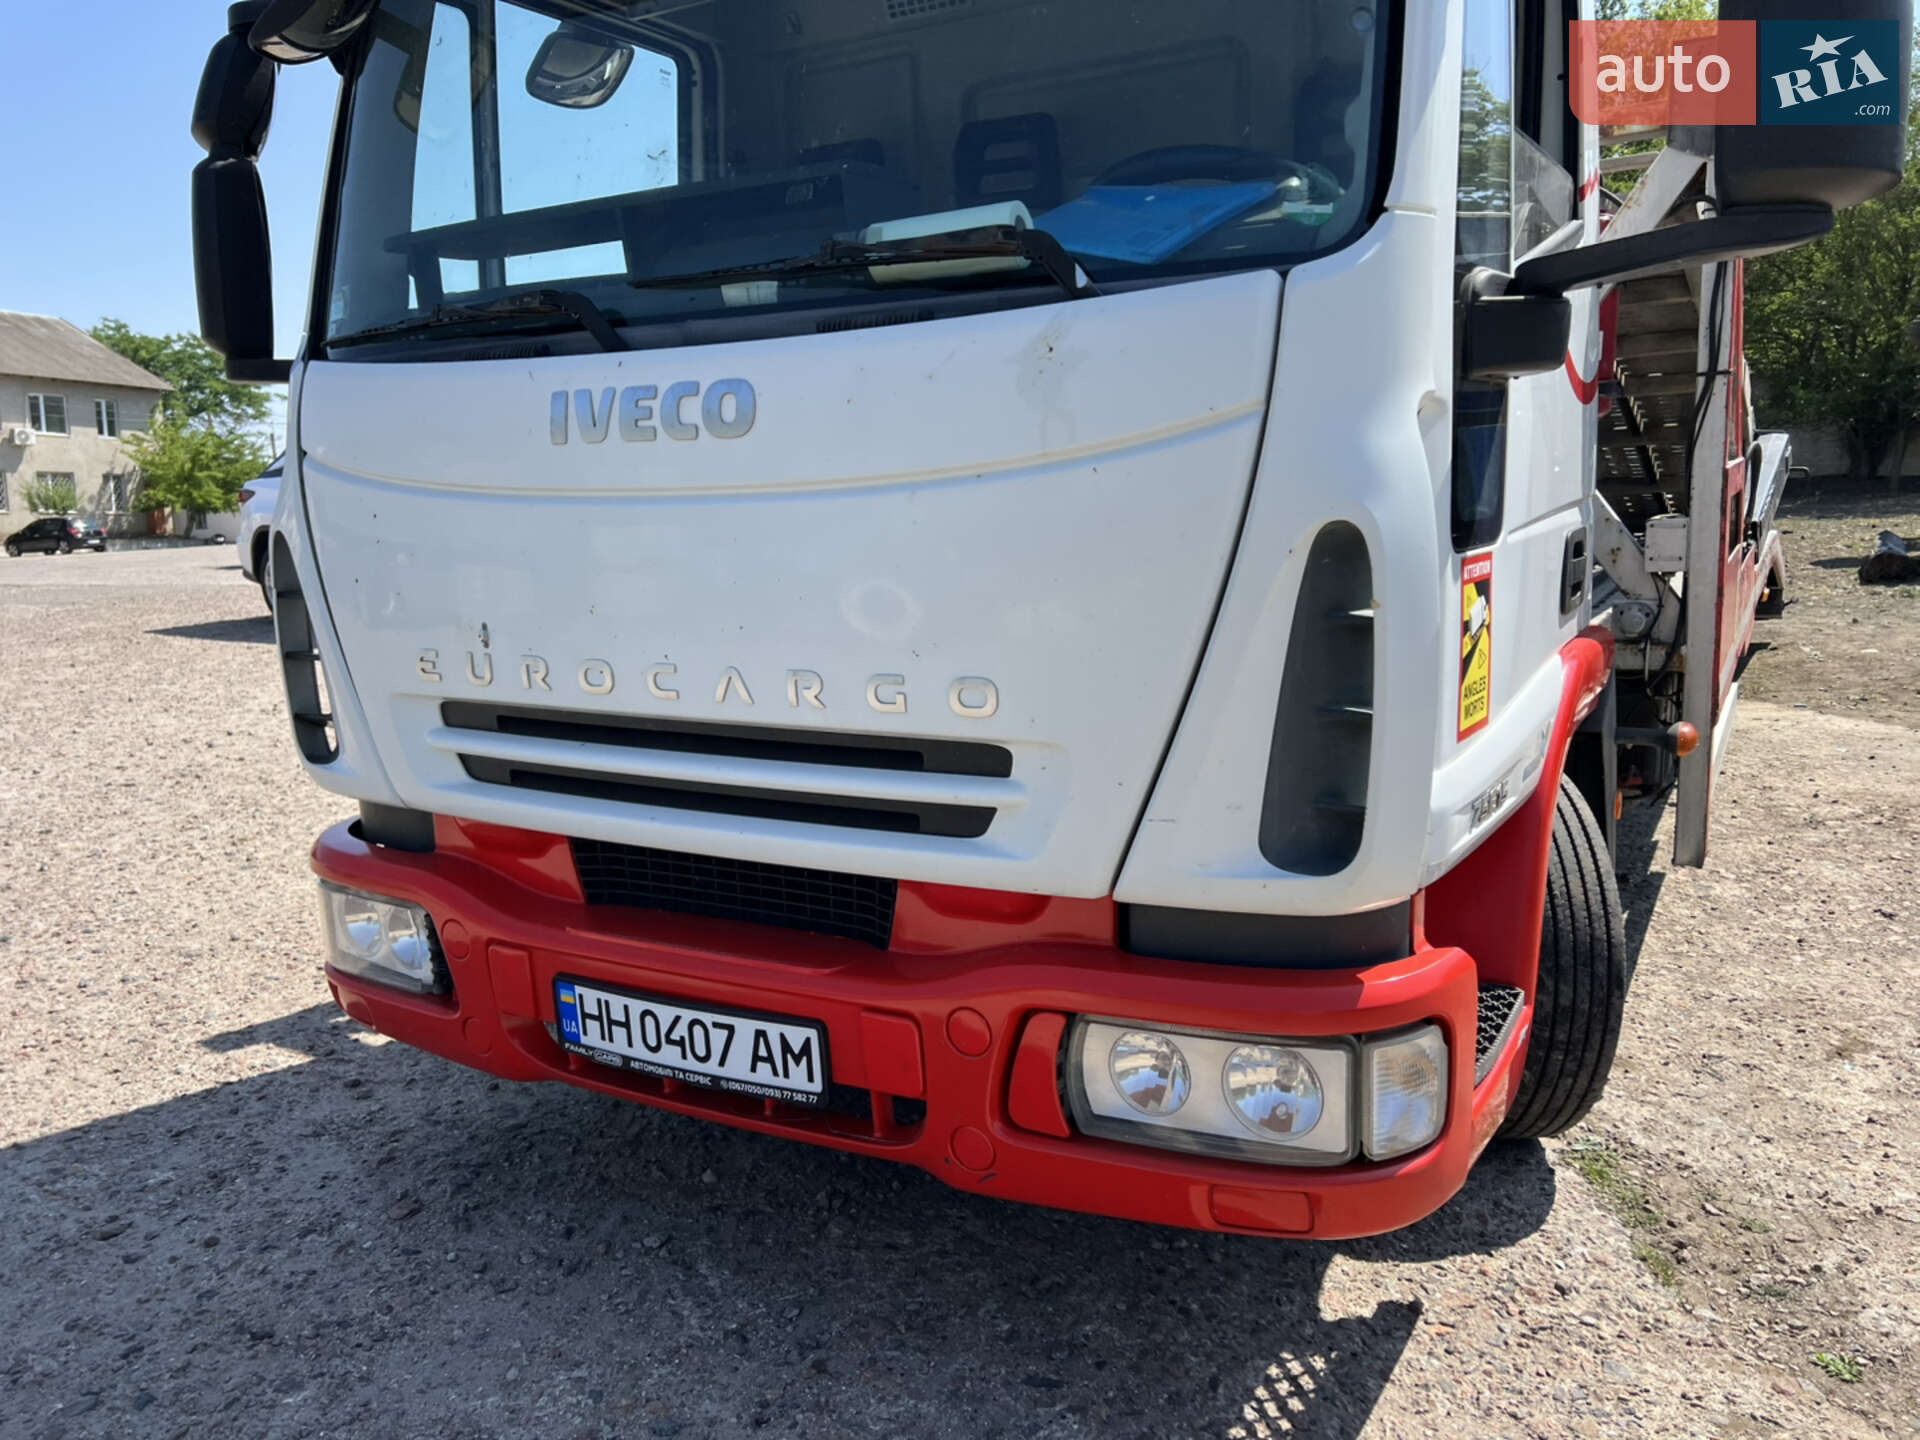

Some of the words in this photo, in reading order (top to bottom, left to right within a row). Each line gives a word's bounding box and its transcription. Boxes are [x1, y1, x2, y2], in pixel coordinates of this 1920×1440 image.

[550, 378, 756, 445] IVECO
[1463, 559, 1491, 580] ATTENTION
[415, 648, 1000, 719] EUROCARGO
[1463, 675, 1487, 700] ANGLES
[1463, 696, 1485, 720] MORTS
[562, 1018, 579, 1034] UA
[750, 1029, 815, 1084] AM
